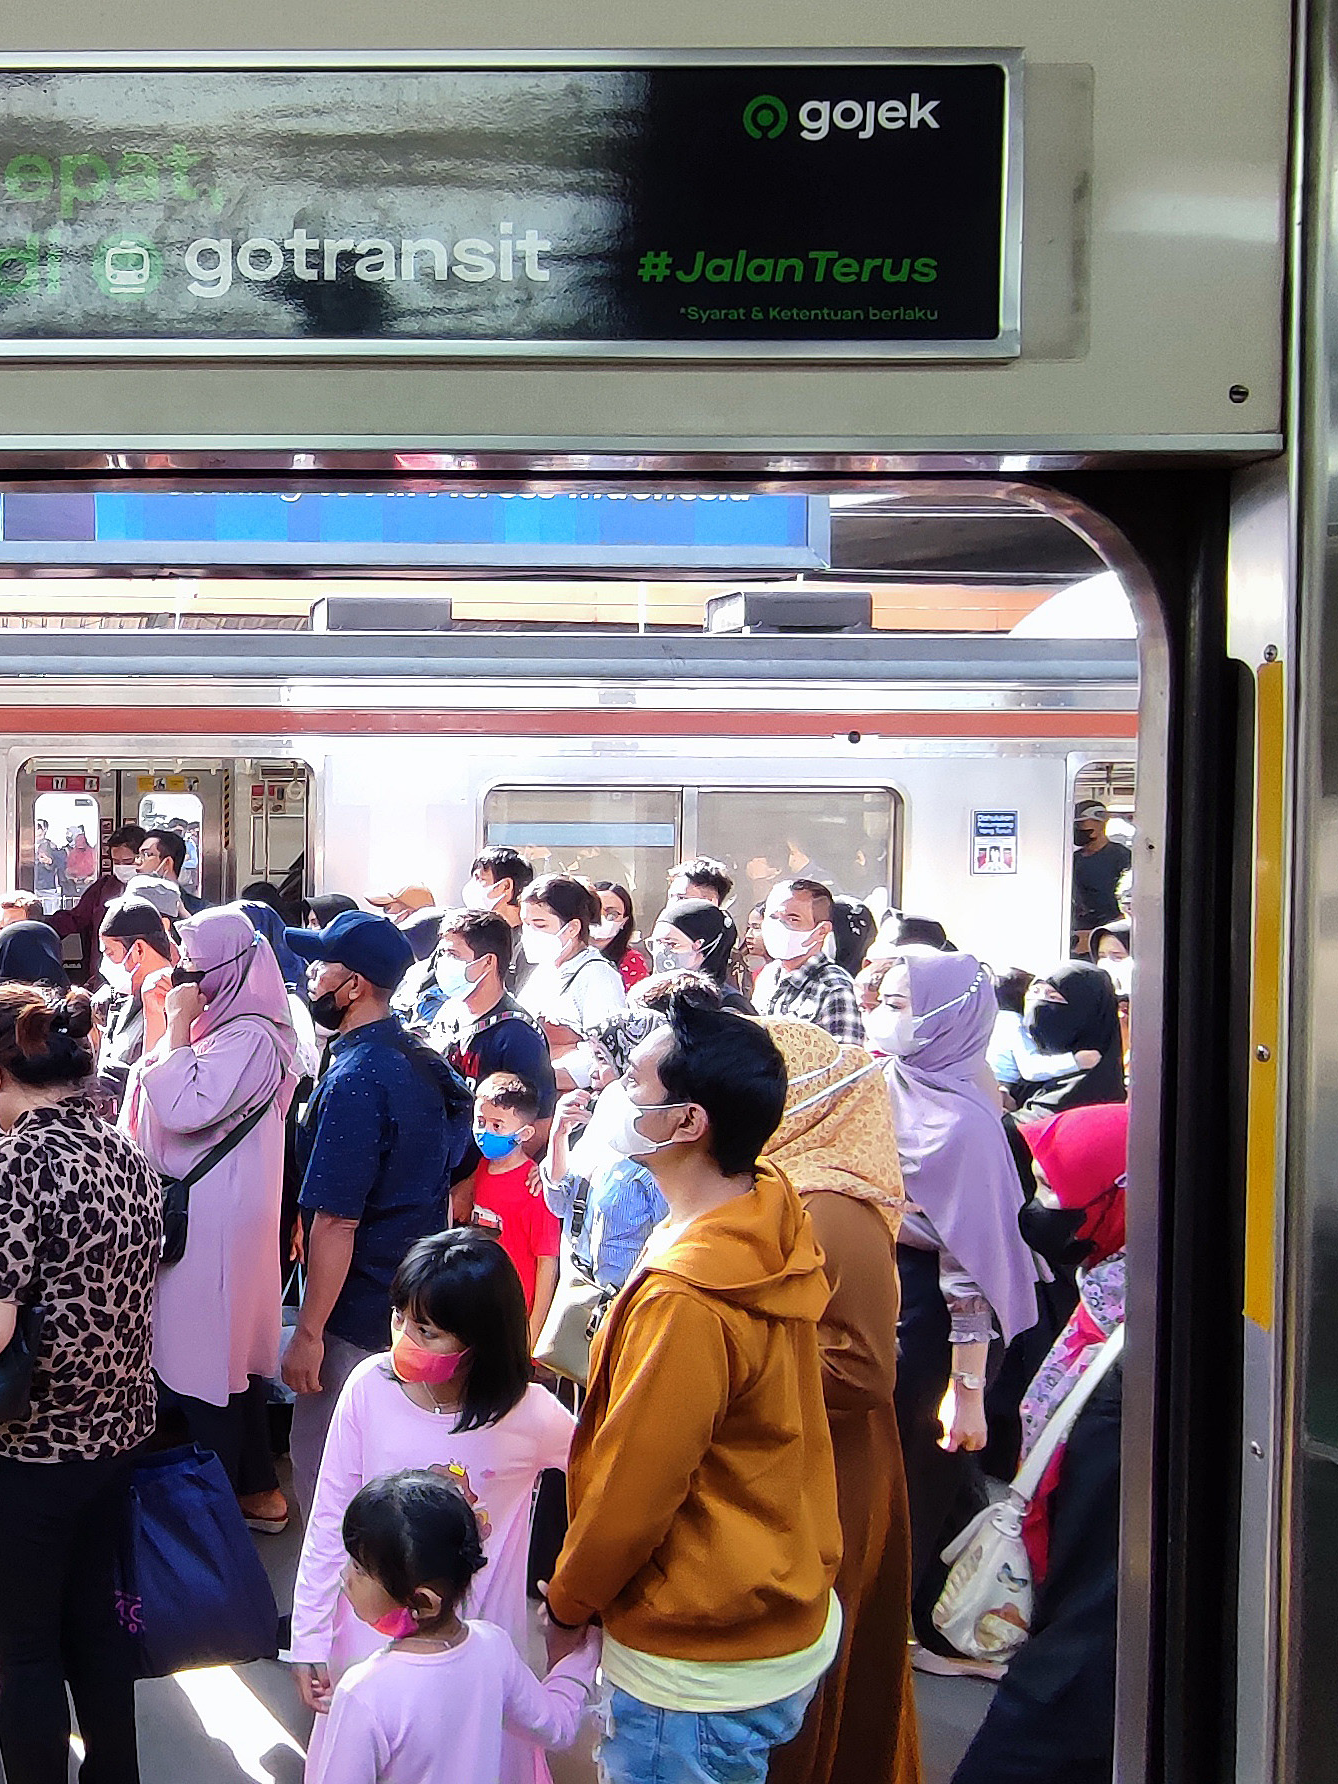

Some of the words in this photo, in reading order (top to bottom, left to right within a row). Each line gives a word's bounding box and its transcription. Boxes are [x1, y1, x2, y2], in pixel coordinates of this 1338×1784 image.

[799, 93, 941, 141] gojek
[184, 222, 552, 299] gotransit
[637, 250, 938, 283] #JalanTerus
[752, 307, 764, 320] &
[769, 306, 864, 321] Ketentuan
[869, 306, 938, 321] berlaku
